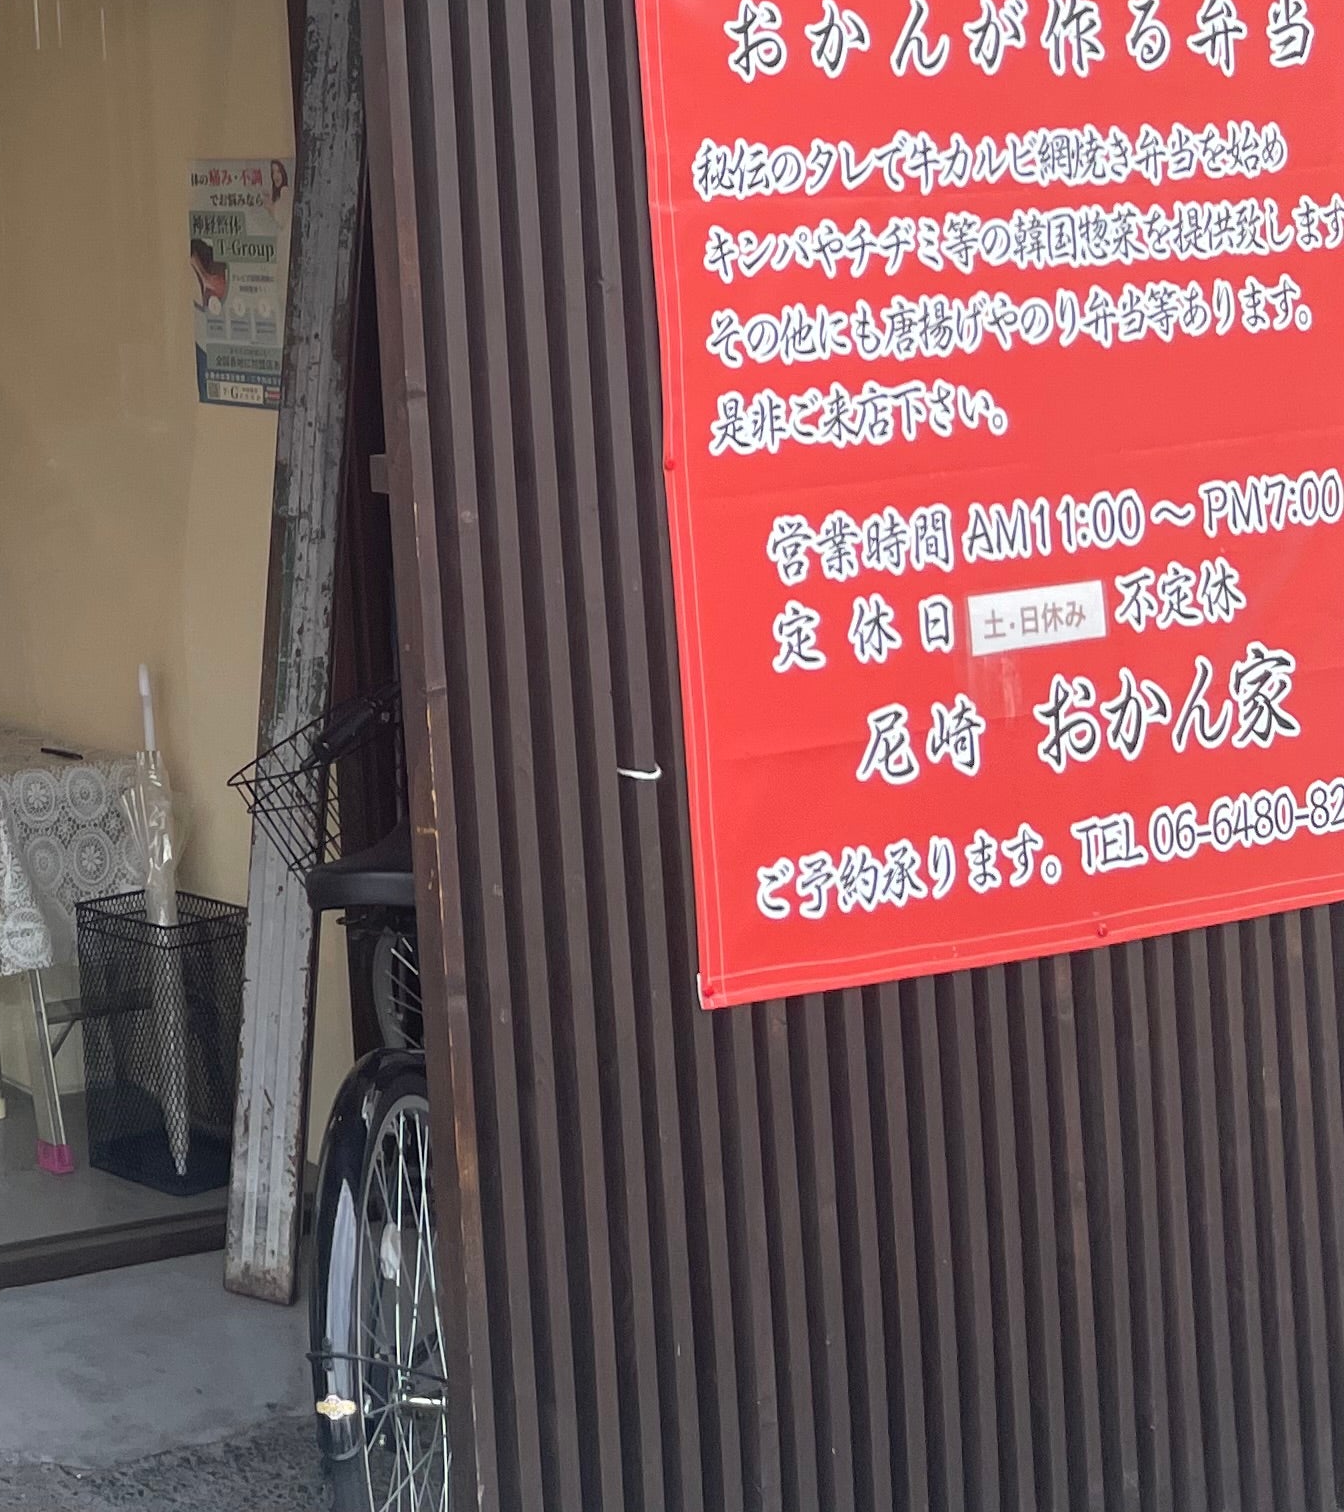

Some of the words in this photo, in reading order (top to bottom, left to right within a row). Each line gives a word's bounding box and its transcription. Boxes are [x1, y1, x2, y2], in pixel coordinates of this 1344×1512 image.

[693, 121, 1288, 201] 秘伝のタレで牛カルビ網焼き弁当を始め
[217, 239, 275, 262] T-Group
[708, 274, 1312, 365] その他にも唐揚げやのり弁当等あります。
[709, 381, 1008, 456] 是非ご来店下さい。
[768, 504, 953, 585] 営業時間
[1114, 558, 1247, 631] 不定休
[857, 694, 985, 784] 尼崎
[1037, 641, 1300, 771] おかん家
[755, 824, 1062, 918] ご予約承ります。
[1071, 813, 1148, 875] TEL
